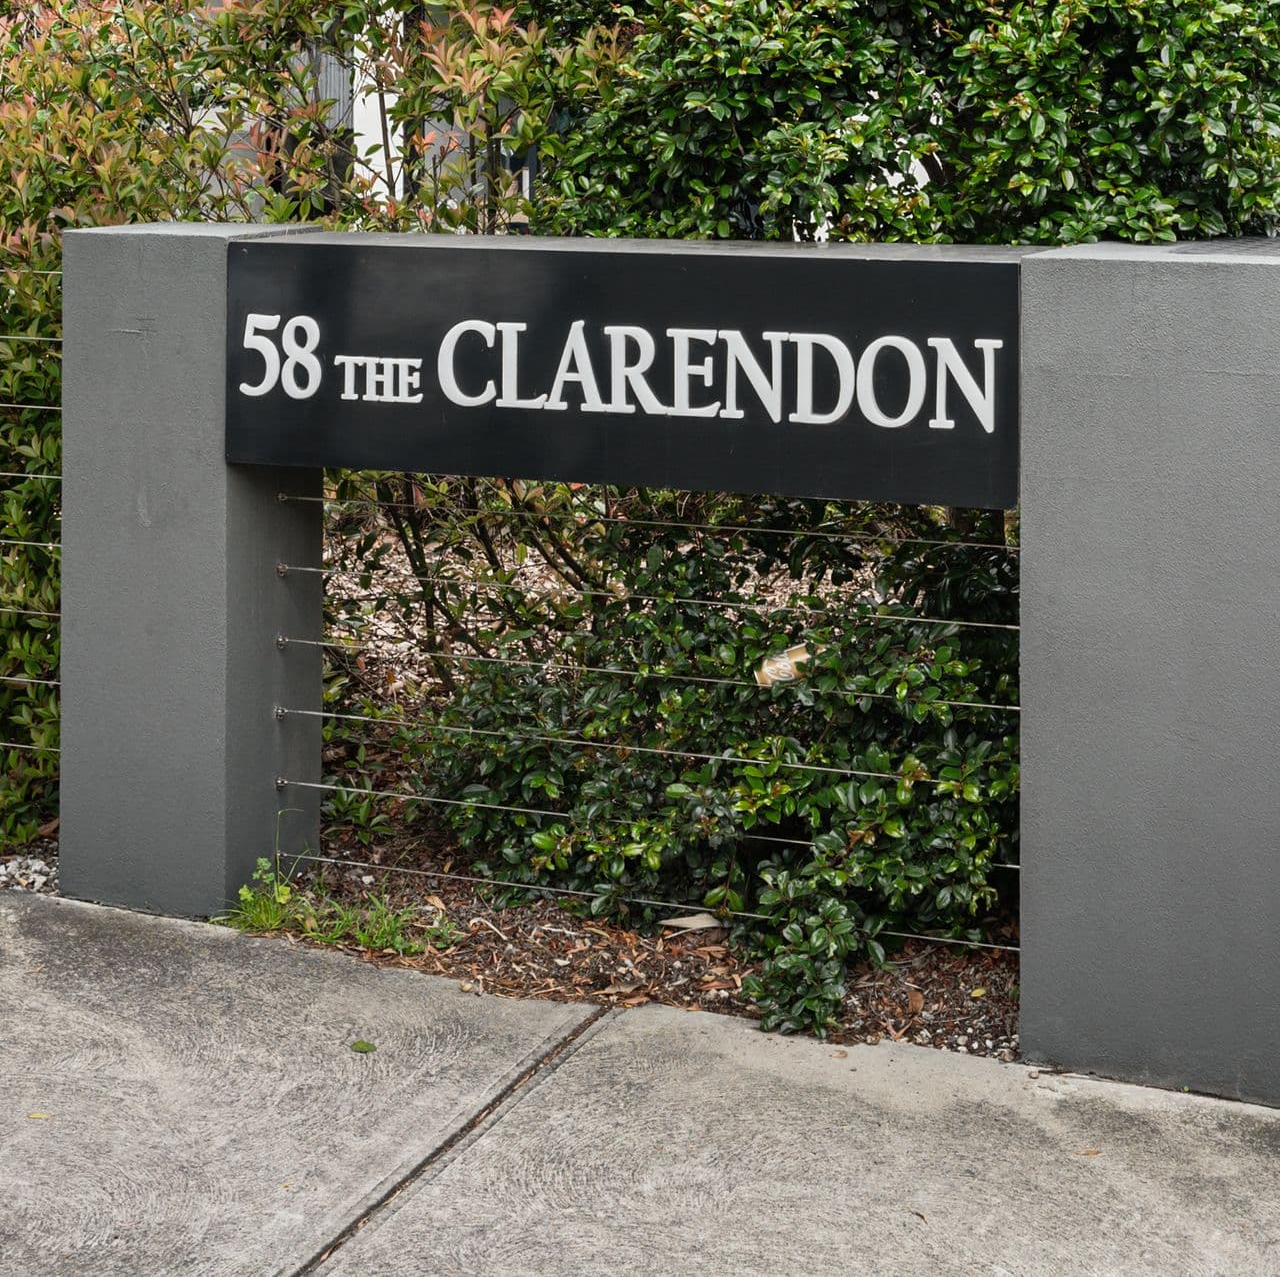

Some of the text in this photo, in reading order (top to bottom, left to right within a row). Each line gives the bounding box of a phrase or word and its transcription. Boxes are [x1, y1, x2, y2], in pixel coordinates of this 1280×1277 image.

[239, 313, 1004, 434] 58 THE CLARENDON
